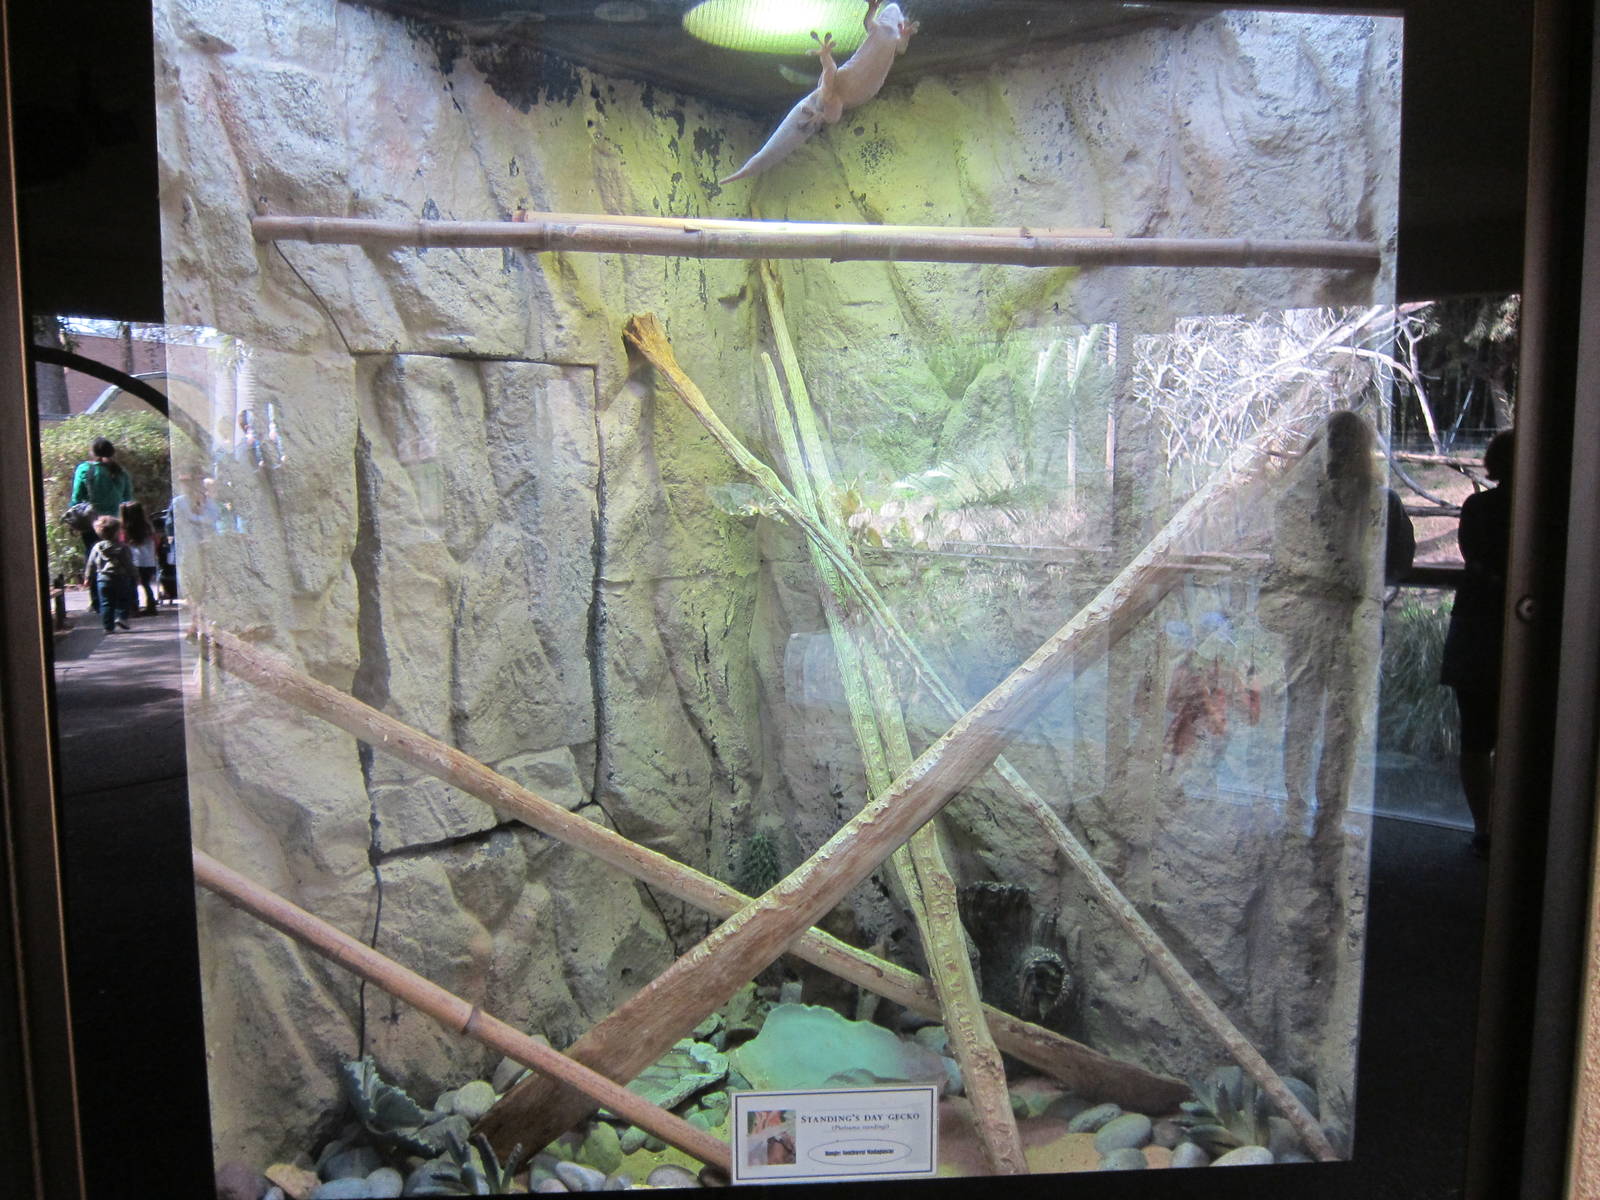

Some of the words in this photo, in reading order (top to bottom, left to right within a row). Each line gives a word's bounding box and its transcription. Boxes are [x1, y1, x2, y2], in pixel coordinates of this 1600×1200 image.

[800, 1113, 860, 1124] STANDING'S
[864, 1113, 883, 1122] DAY
[888, 1112, 920, 1121] GECKO
